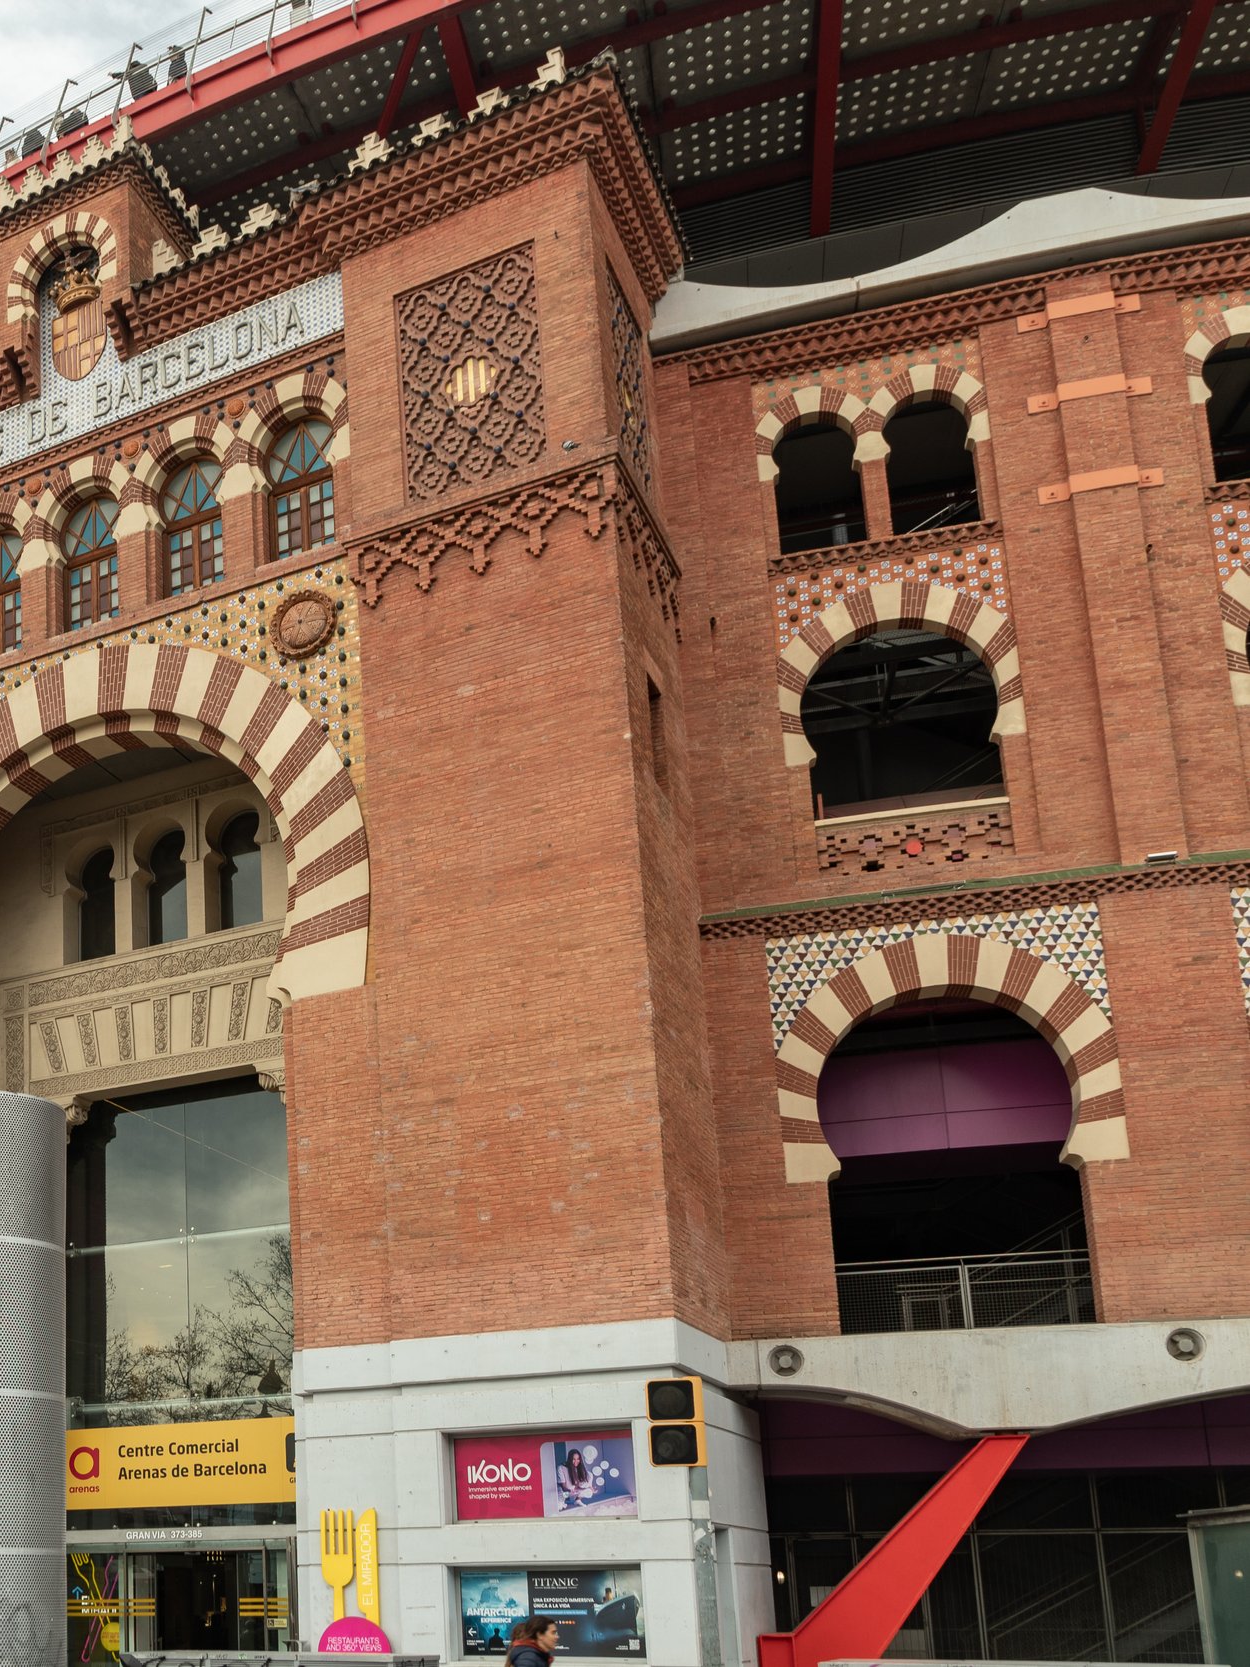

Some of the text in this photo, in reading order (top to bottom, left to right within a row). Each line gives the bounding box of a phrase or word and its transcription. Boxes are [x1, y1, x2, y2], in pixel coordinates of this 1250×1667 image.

[26, 400, 68, 445] DE
[92, 302, 305, 418] BARCELONA
[118, 1438, 239, 1458] Centre Comercial
[118, 1461, 267, 1480] Arenas de Barcelona
[467, 1458, 532, 1484] IKONO
[69, 1485, 100, 1493] arenas
[126, 1530, 203, 1539] GRAN VIA 373-385
[360, 1523, 374, 1606] EL MIRADOR
[532, 1577, 579, 1587] TITANIC
[466, 1607, 526, 1617] ANTARCTICA
[326, 1644, 341, 1652] AND
[359, 1644, 382, 1652] VIEWS
